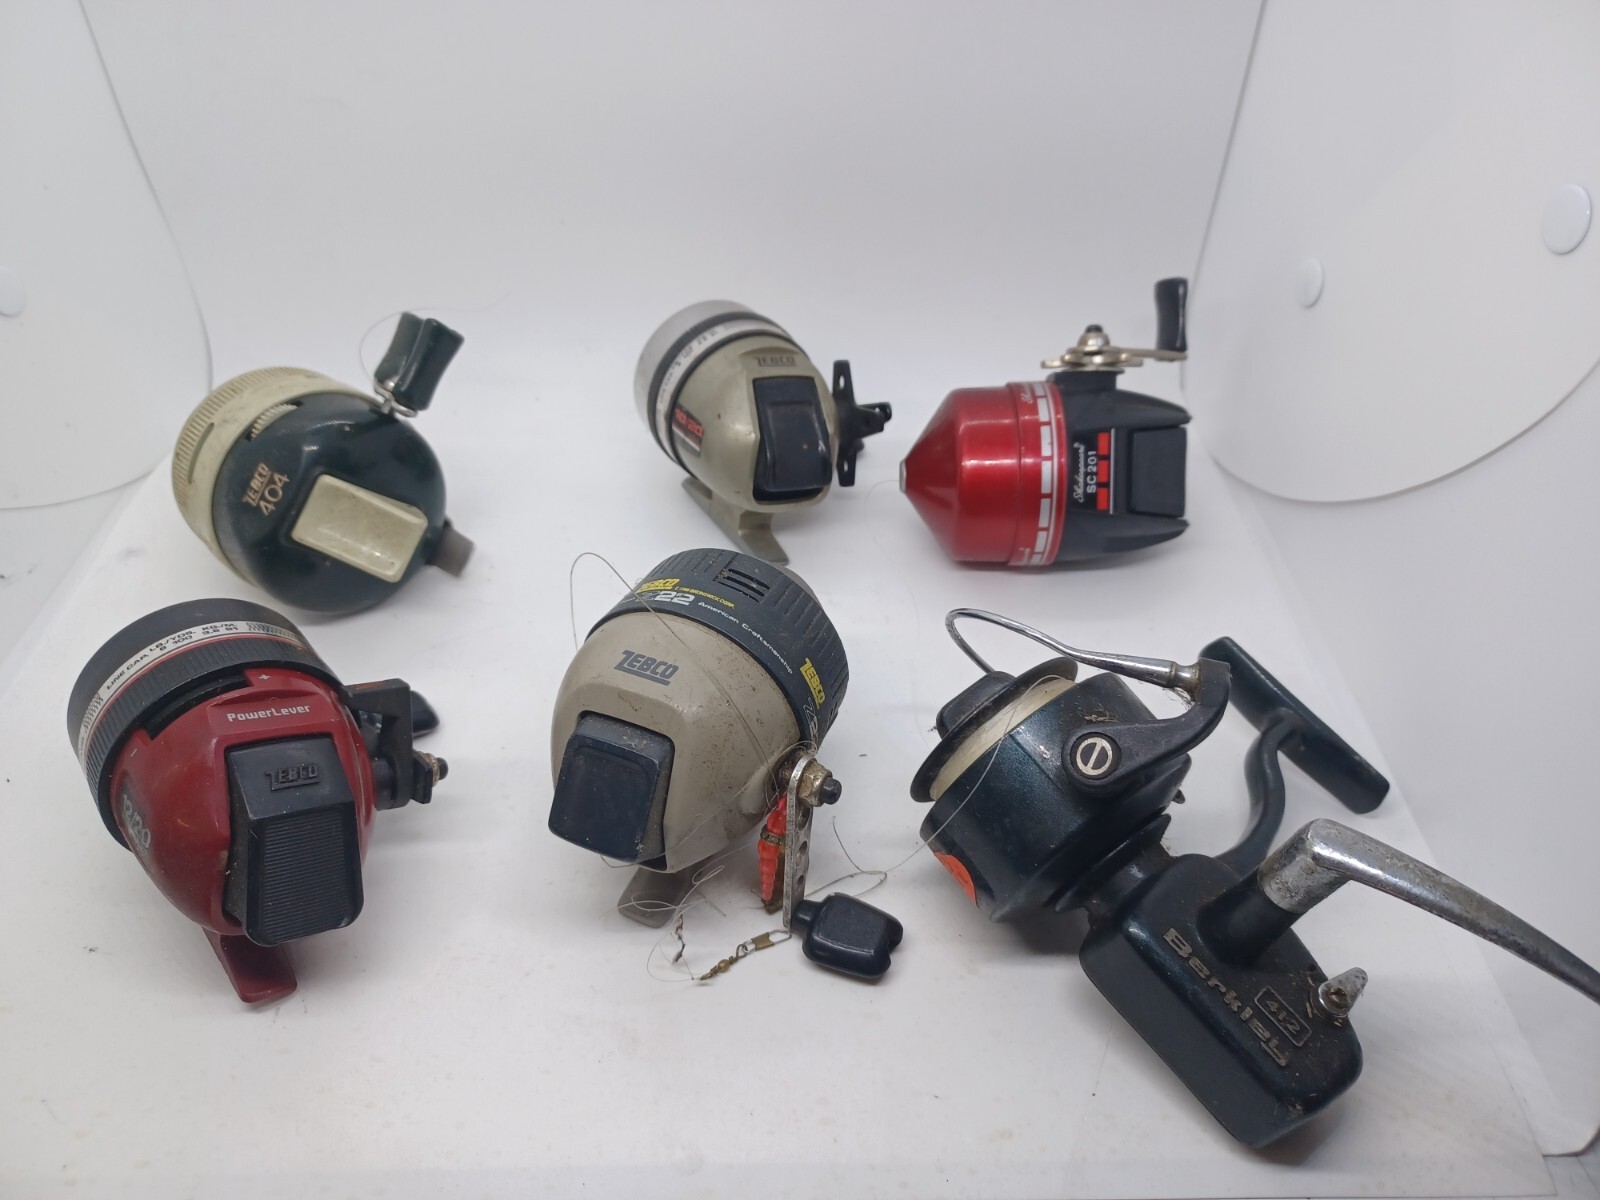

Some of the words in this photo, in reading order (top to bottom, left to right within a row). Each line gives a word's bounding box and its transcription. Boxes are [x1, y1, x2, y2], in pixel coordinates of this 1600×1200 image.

[753, 355, 797, 368] ZEBCO
[1087, 451, 1098, 472] 201
[242, 462, 272, 507] ZEBCO
[259, 473, 290, 516] 404
[1086, 474, 1098, 493] SC
[172, 635, 193, 645] 100
[698, 602, 740, 624] American
[741, 622, 793, 675] Craftsmanship
[106, 669, 127, 691] LINE
[614, 648, 680, 687] ZEBCO
[800, 656, 827, 711] ZEBCO
[226, 704, 311, 723] PowerLever
[265, 762, 321, 792] ZEBCO
[1162, 927, 1289, 1068] Berkley
